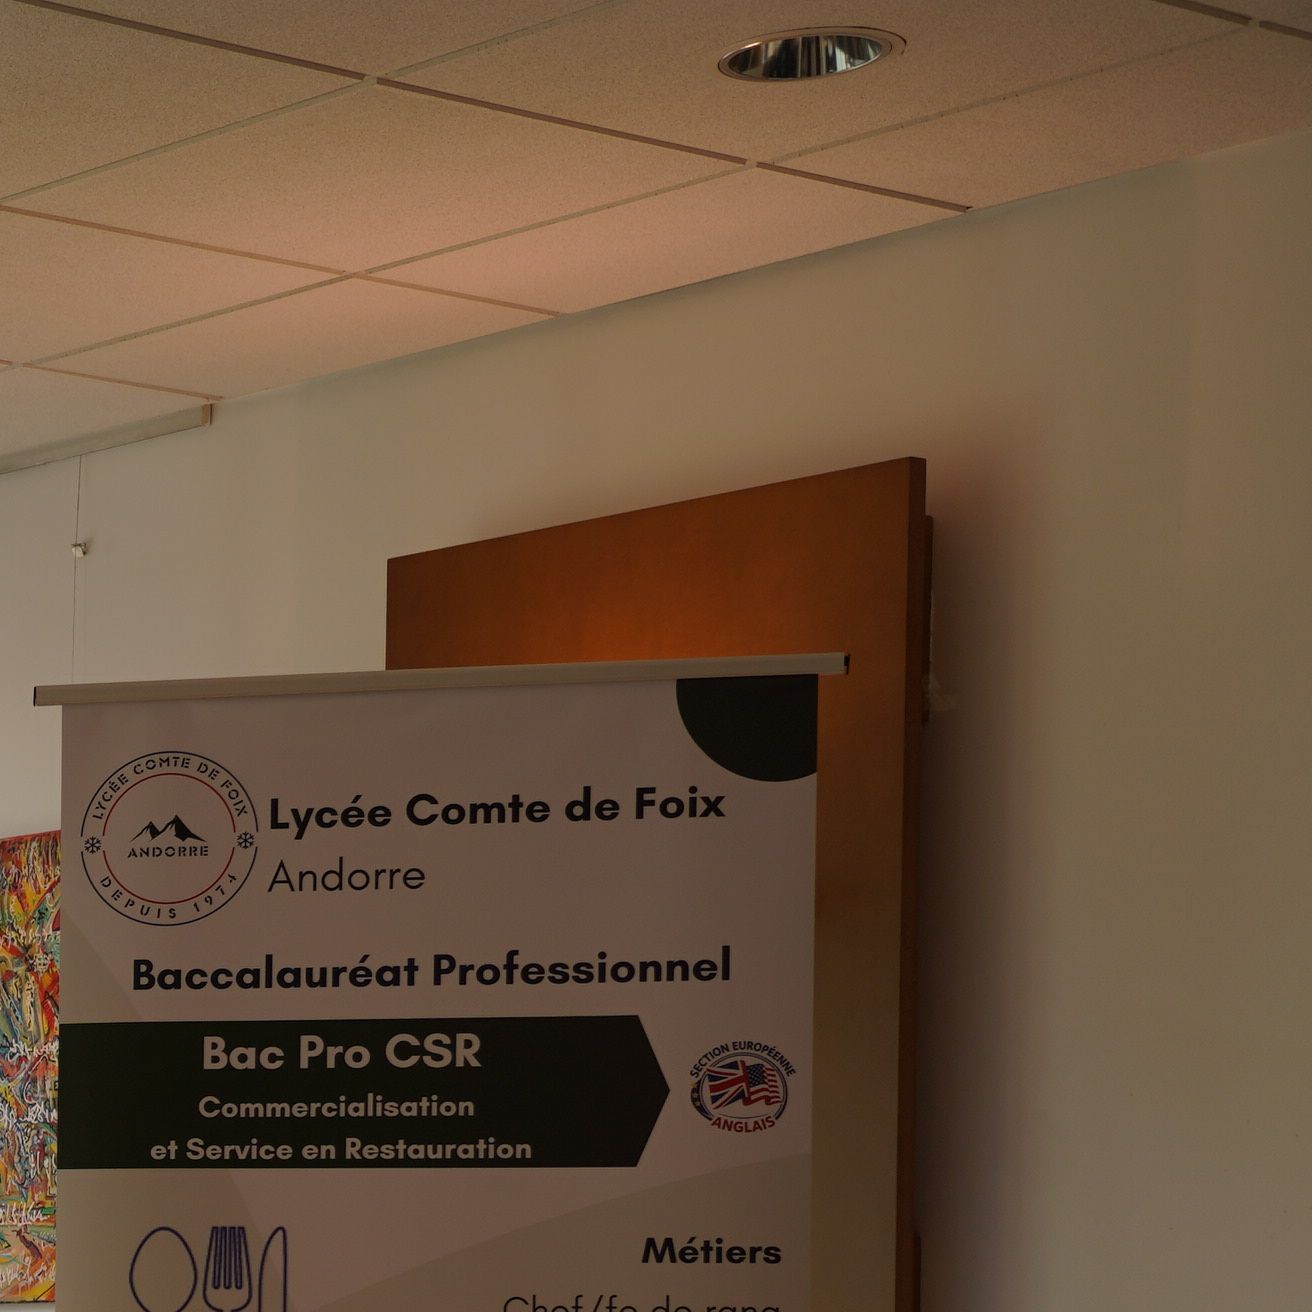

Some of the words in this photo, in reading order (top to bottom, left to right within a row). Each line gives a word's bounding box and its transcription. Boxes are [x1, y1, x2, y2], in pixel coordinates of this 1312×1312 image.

[92, 773, 129, 820] LYCÉE
[133, 756, 191, 775] COMTE
[197, 762, 220, 781] DE
[221, 779, 248, 817] FOIX
[271, 795, 391, 840] Lycée
[406, 794, 550, 826] Comte
[565, 786, 619, 821] de
[636, 786, 725, 819] Foix
[128, 846, 208, 858] ANDORRE
[268, 856, 425, 892] Andorre
[100, 876, 177, 919] DEPUIS
[133, 954, 419, 990] Baccalauréat
[434, 945, 730, 985] Professionnel
[204, 1036, 284, 1069] Bac
[300, 1035, 370, 1068] Pro
[386, 1033, 481, 1068] CSR
[690, 1043, 729, 1078] SECTION
[732, 1041, 796, 1077] EUROPÉENNE
[199, 1093, 474, 1118] Commercialisation
[712, 1116, 776, 1133] ANGLAIS
[151, 1140, 178, 1159] et
[186, 1138, 293, 1159] Service
[302, 1145, 335, 1159] en
[346, 1137, 531, 1159] Restauration
[642, 1237, 781, 1264] Métiers
